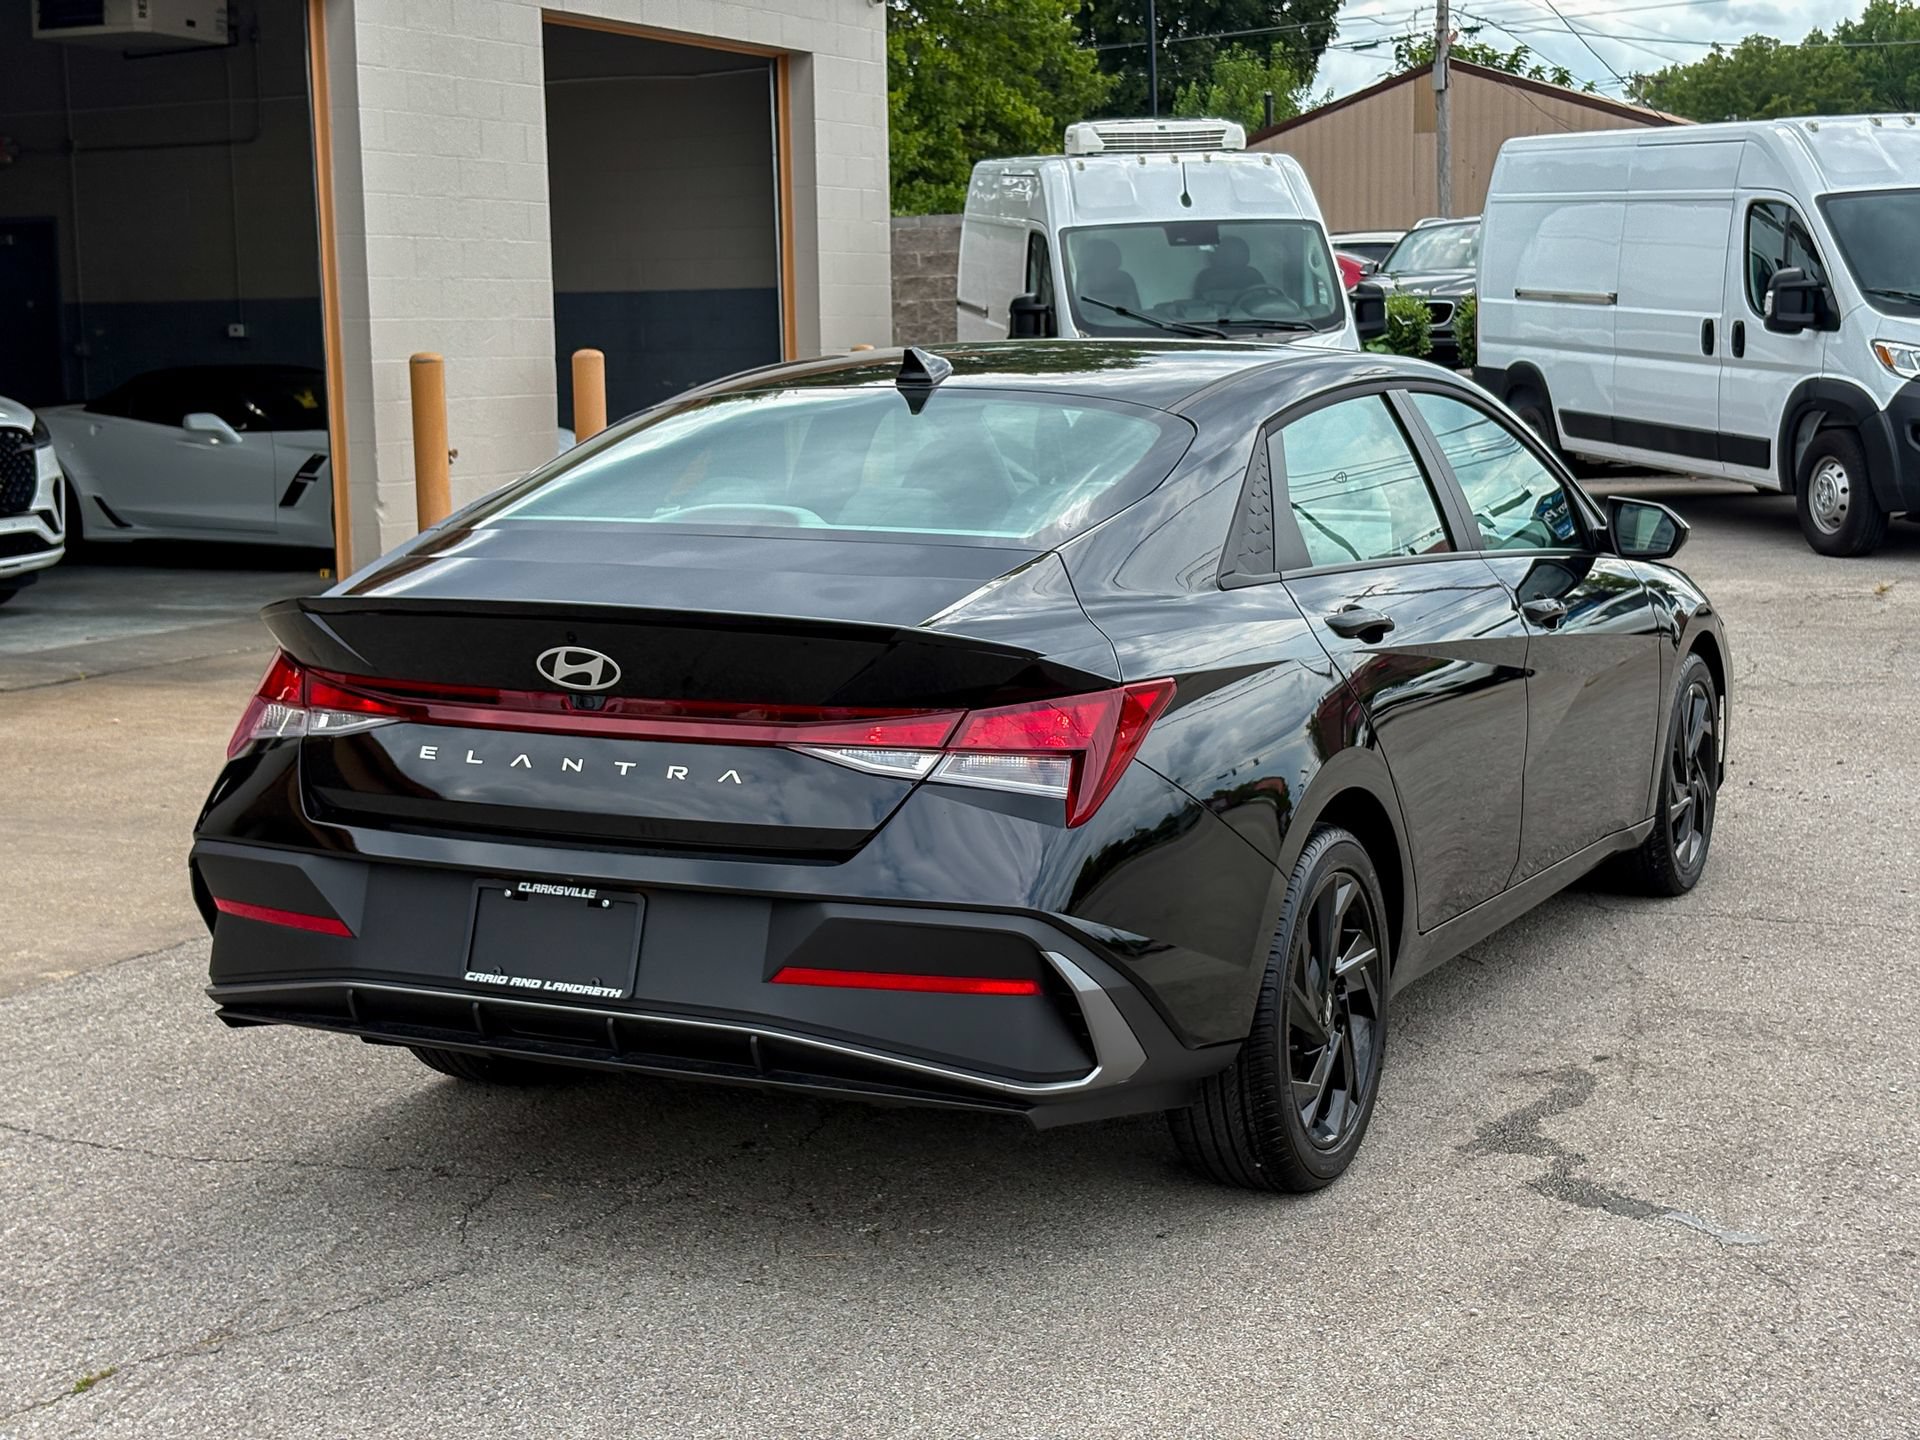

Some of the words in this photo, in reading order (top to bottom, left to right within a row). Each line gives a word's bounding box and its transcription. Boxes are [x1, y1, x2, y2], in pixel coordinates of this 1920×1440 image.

[419, 745, 742, 784] ELANTRA
[518, 882, 597, 899] CLARKSVILLE
[509, 976, 542, 989] AND
[543, 980, 623, 998] LANDRETH
